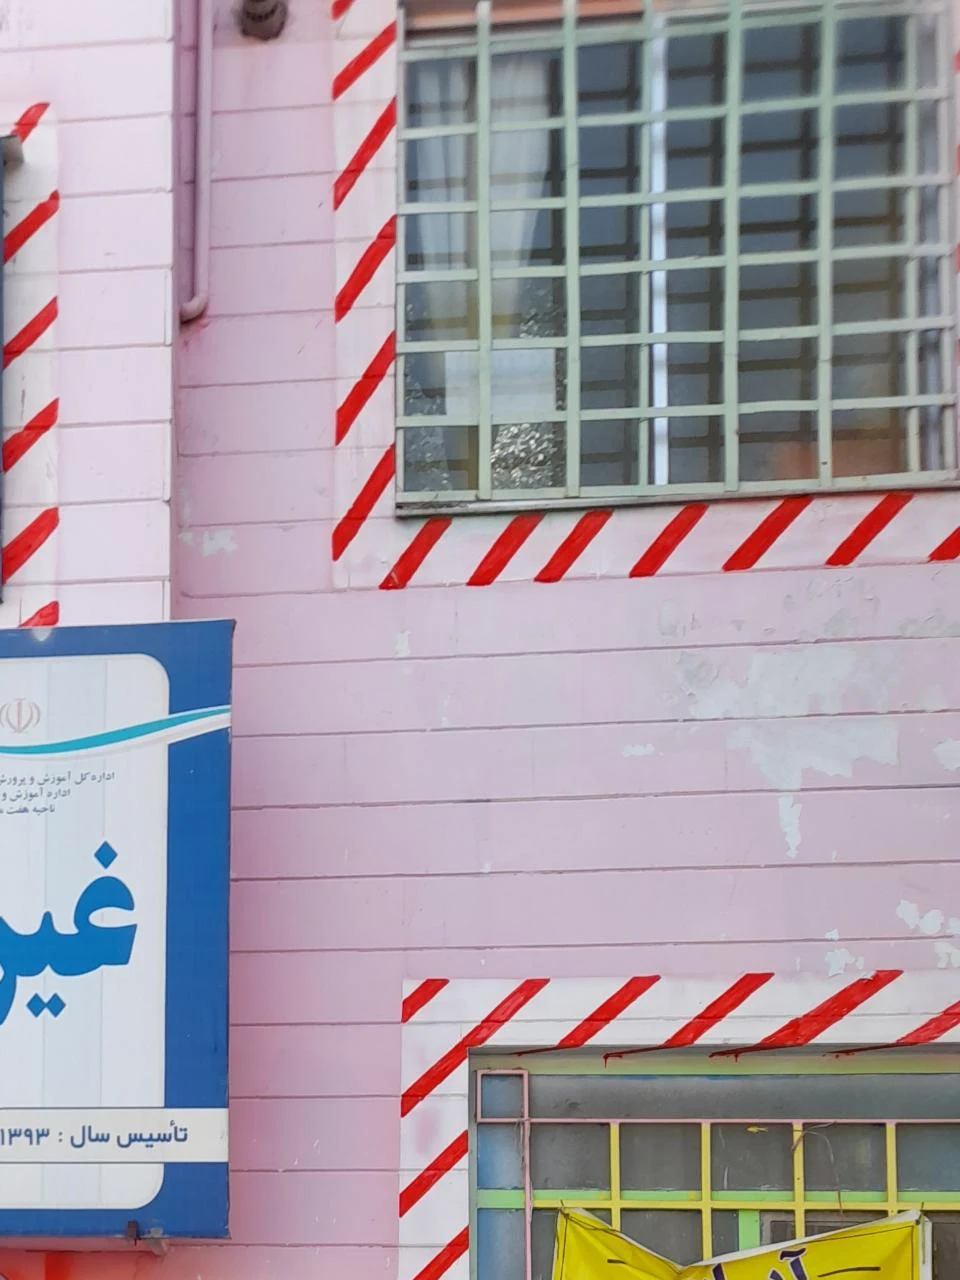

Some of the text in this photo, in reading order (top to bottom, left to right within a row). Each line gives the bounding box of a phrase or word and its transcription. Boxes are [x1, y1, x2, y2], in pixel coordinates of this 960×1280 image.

[37, 771, 71, 786] آموزش
[9, 787, 44, 802] آموزش
[6, 805, 29, 816] هفت
[32, 804, 56, 817] ناحیه
[0, 1127, 50, 1146] ۱۳۹۳
[70, 1125, 110, 1148] سال
